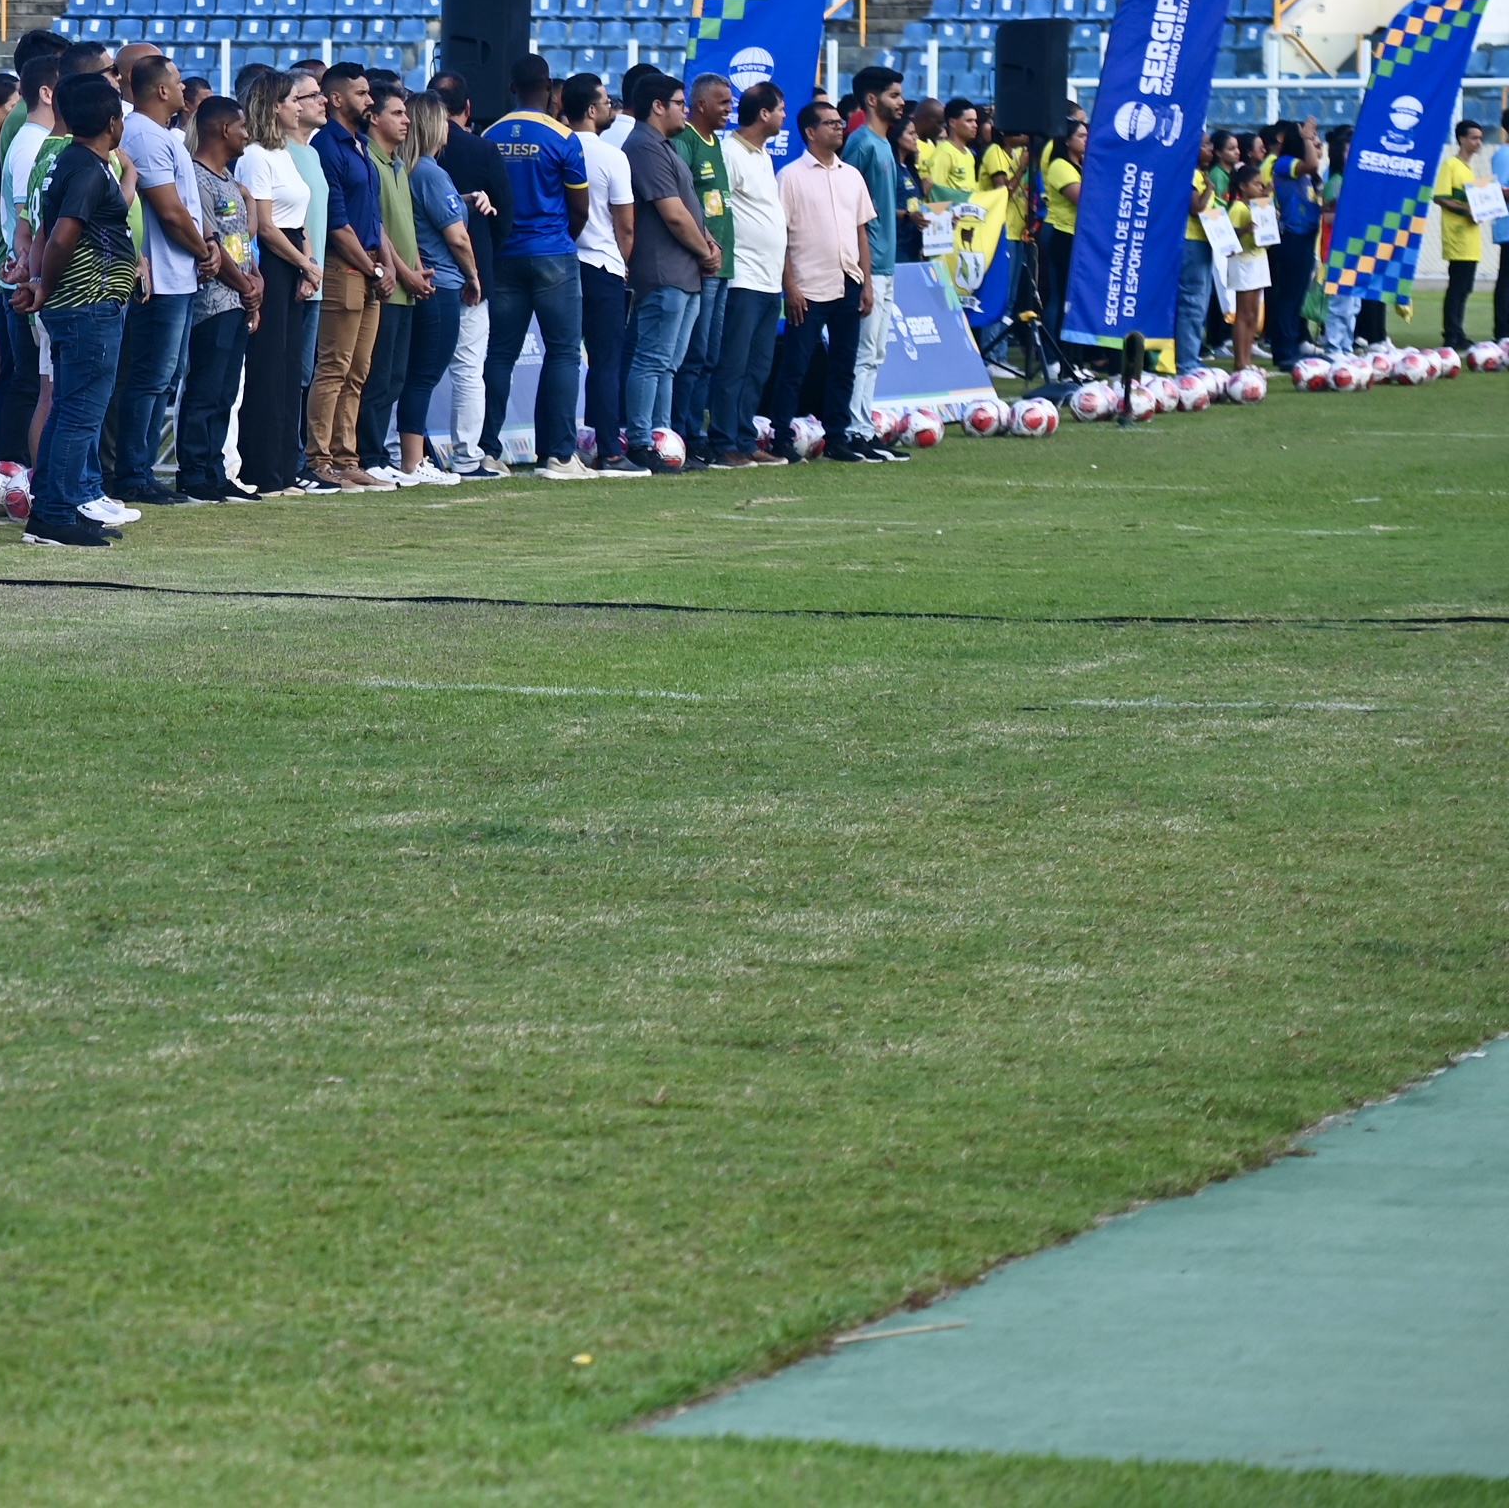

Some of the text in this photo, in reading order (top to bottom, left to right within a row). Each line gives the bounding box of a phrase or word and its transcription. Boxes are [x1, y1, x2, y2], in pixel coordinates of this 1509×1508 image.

[737, 65, 767, 73] PORVIR
[1162, 43, 1181, 96] GOVERNO
[1173, 25, 1185, 42] DO
[1359, 150, 1425, 175] SERGIPE
[1105, 163, 1137, 326] SECRETARIA DE ESTADO
[1123, 171, 1154, 317] DO ESPORTE E LAZER
